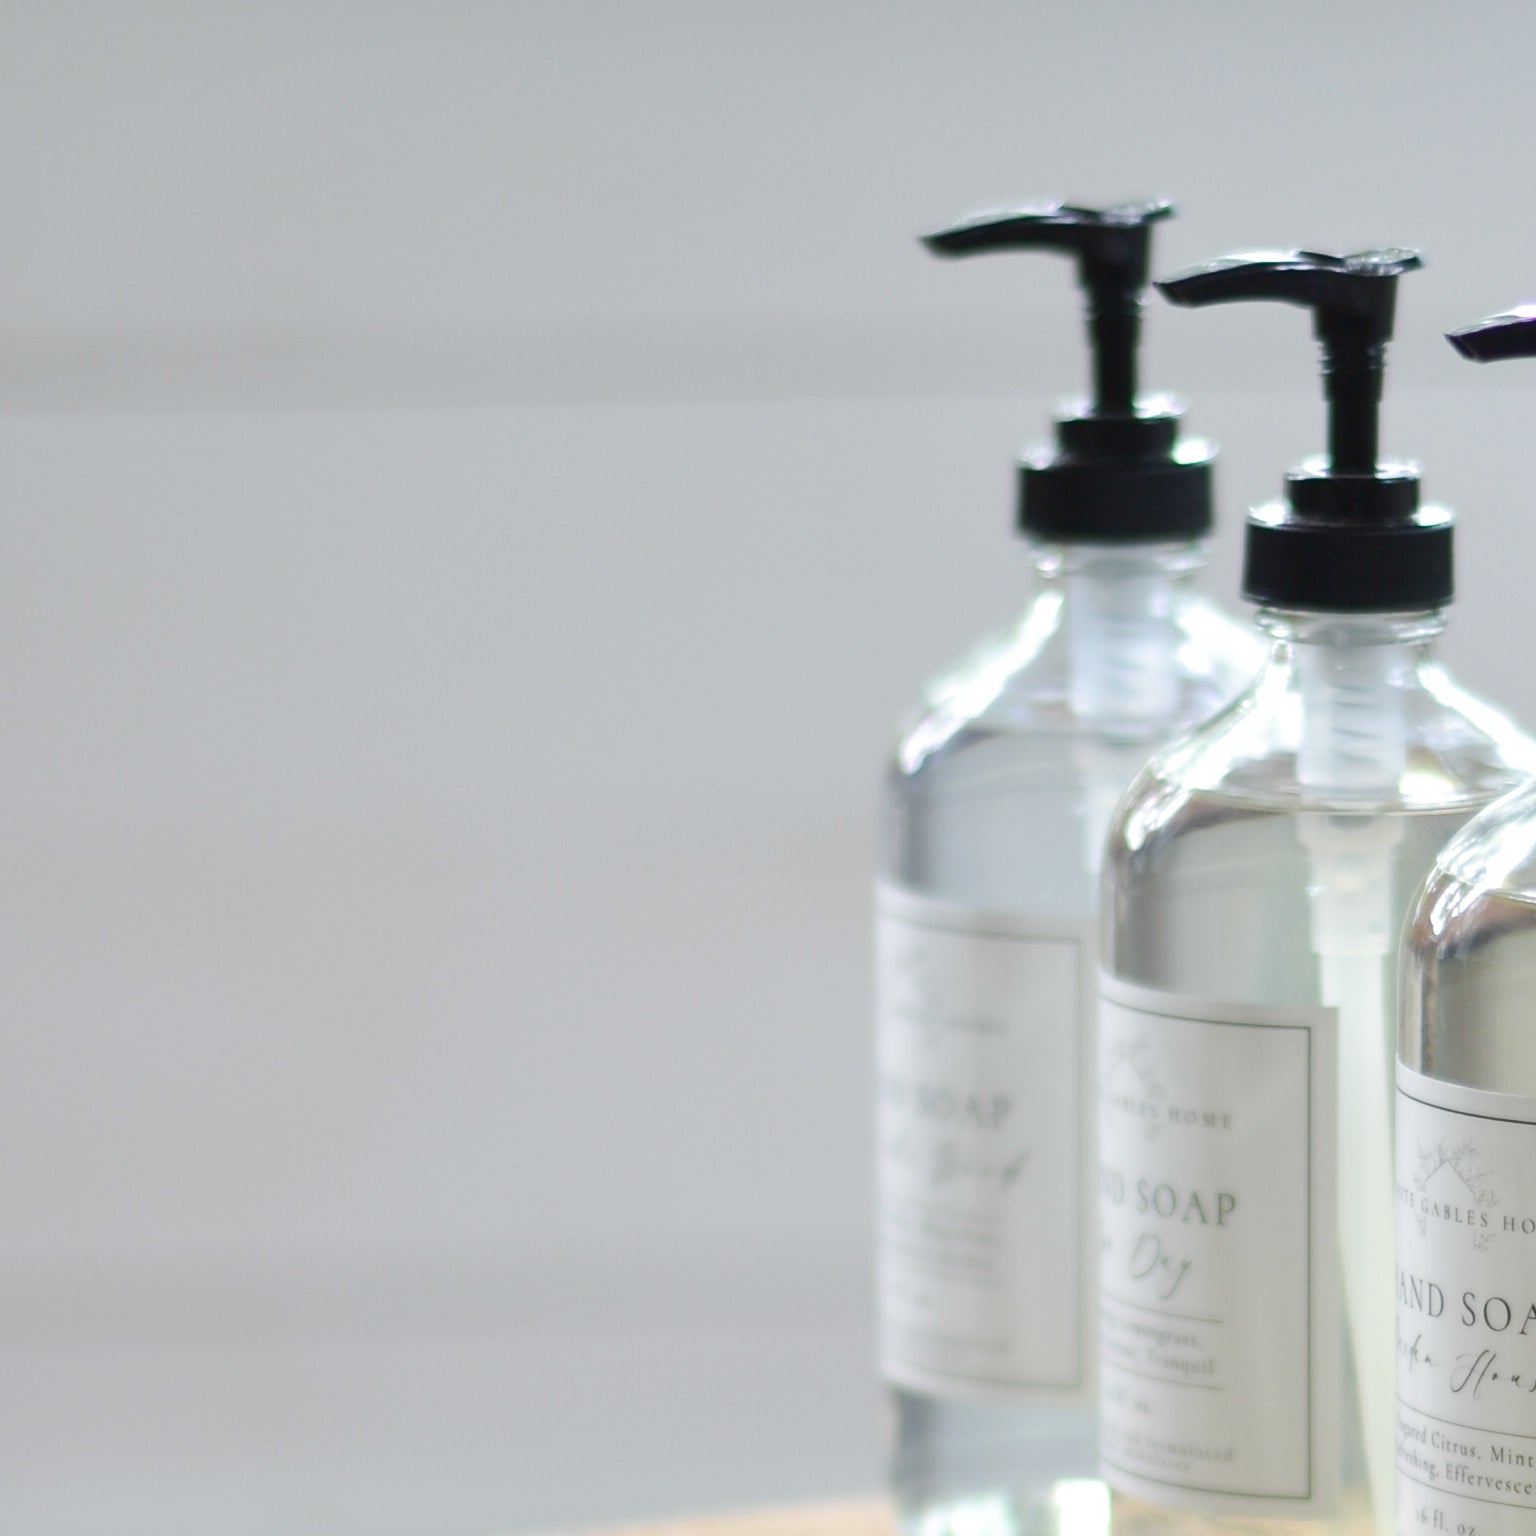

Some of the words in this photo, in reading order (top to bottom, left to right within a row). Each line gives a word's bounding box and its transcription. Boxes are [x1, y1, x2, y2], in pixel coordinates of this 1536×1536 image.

[1168, 1107, 1232, 1130] HOME
[1136, 1178, 1237, 1227] SOAP
[1420, 1197, 1489, 1228] GABLES
